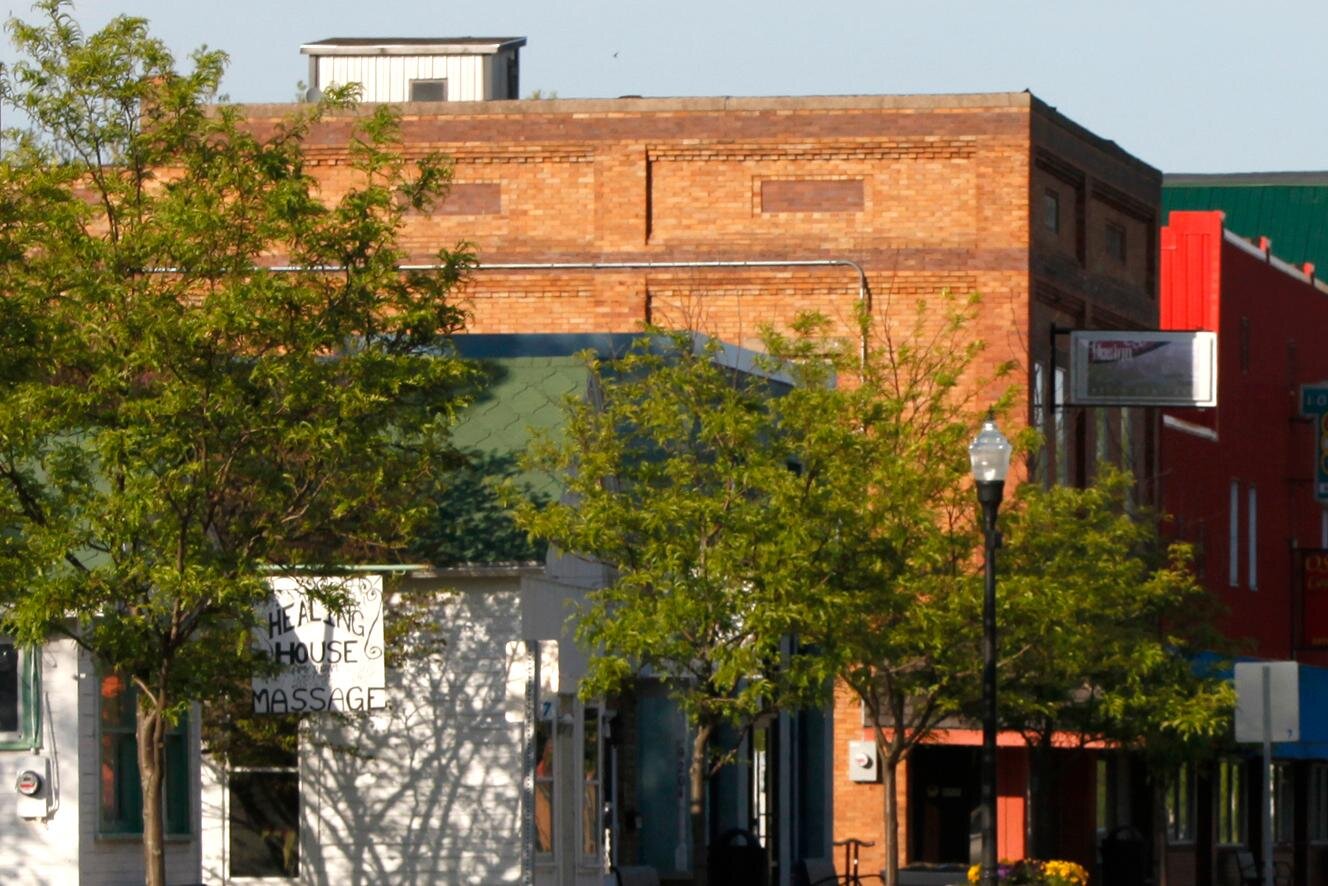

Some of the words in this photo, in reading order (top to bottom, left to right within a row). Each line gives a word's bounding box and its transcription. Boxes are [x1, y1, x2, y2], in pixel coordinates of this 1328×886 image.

[269, 596, 365, 639] HEALING
[275, 641, 358, 665] HOUSE
[253, 686, 386, 712] MASSAGE
